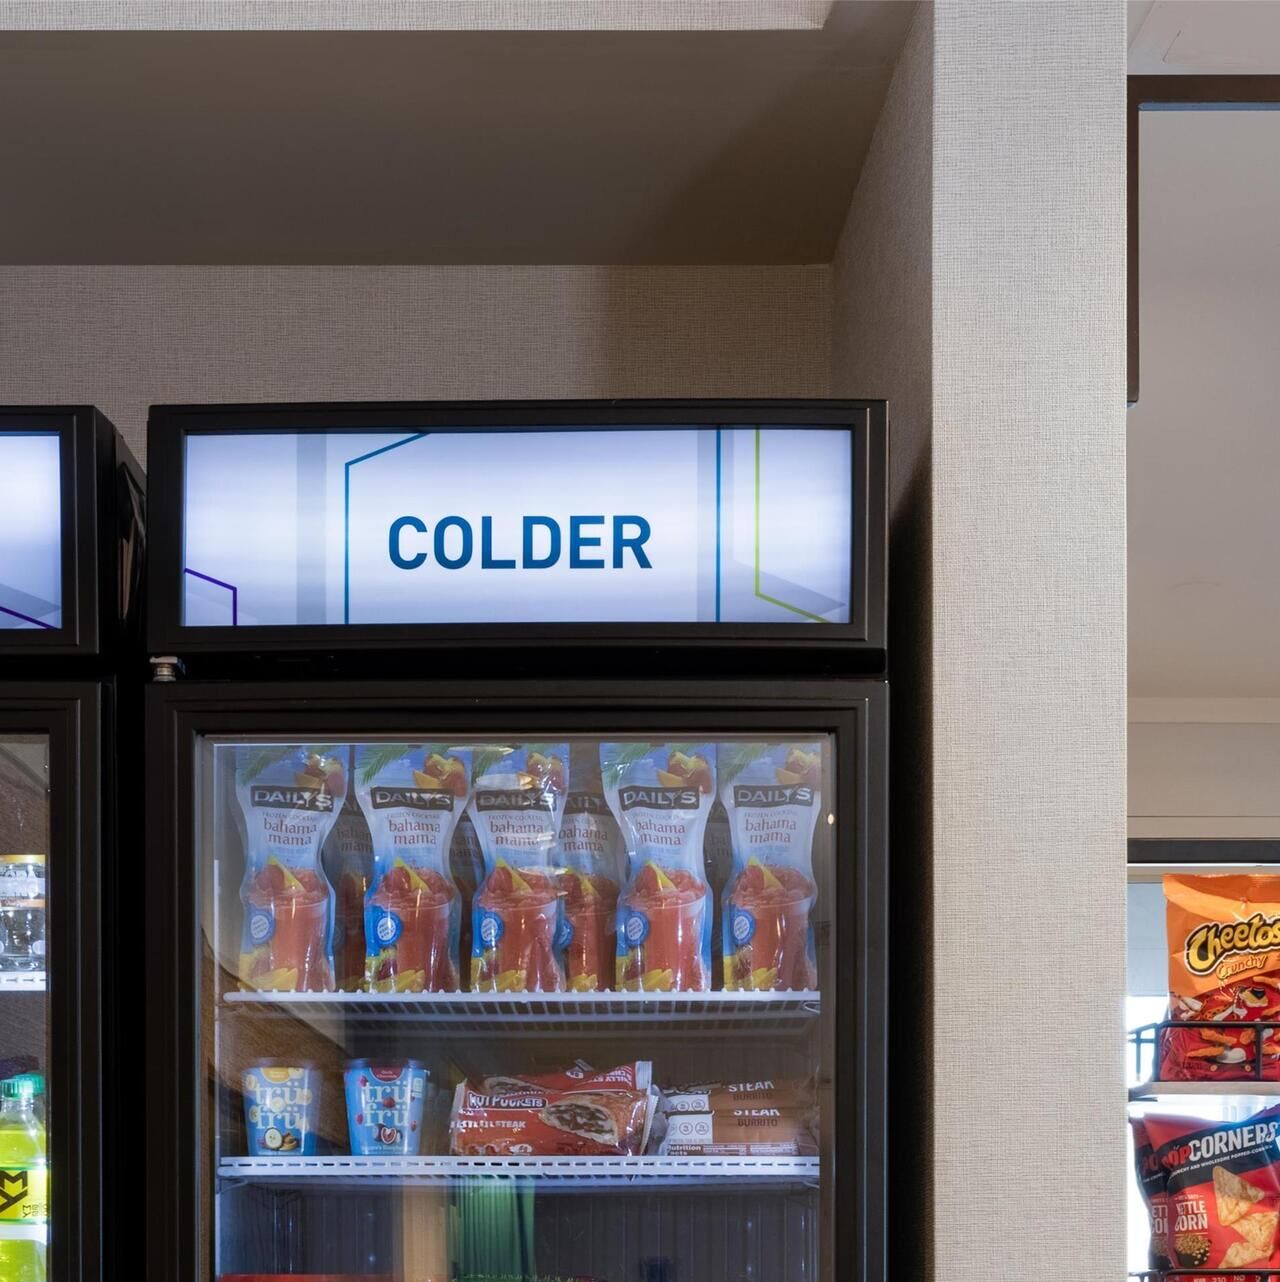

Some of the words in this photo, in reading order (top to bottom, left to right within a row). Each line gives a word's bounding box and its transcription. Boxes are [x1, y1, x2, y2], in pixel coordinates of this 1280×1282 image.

[387, 515, 653, 570] COLDER
[624, 790, 697, 806] DAILY'S
[738, 786, 812, 804] DAILY'S
[744, 818, 797, 832] bahama
[749, 830, 791, 844] mama
[1217, 953, 1268, 980] Crunchy
[255, 1081, 299, 1101] trü
[256, 1103, 300, 1129] frü
